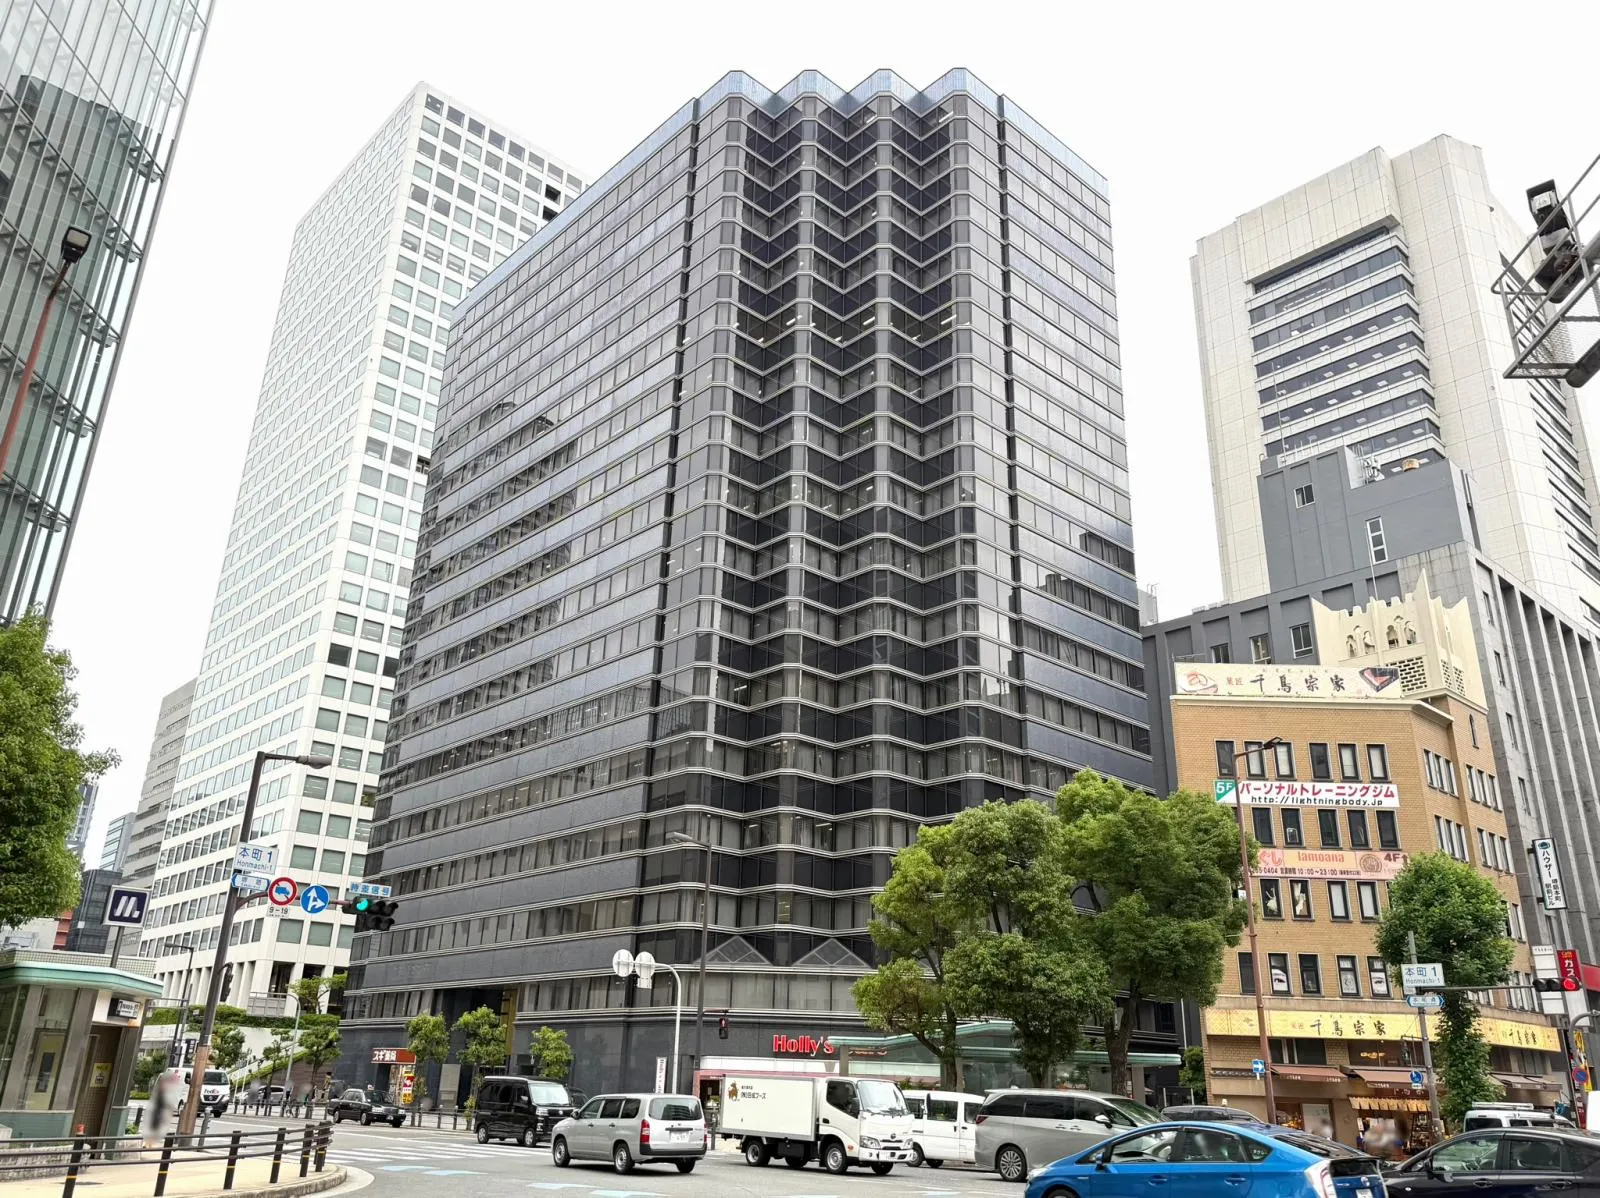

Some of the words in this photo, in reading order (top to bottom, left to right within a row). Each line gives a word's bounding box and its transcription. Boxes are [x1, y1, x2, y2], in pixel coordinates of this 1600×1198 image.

[1216, 782, 1233, 794] 5F
[1239, 782, 1396, 799] パーソナルトレーニングジム
[1383, 853, 1400, 863] 4F
[1542, 850, 1552, 879] ハウザー
[772, 1034, 834, 1056] Holly's
